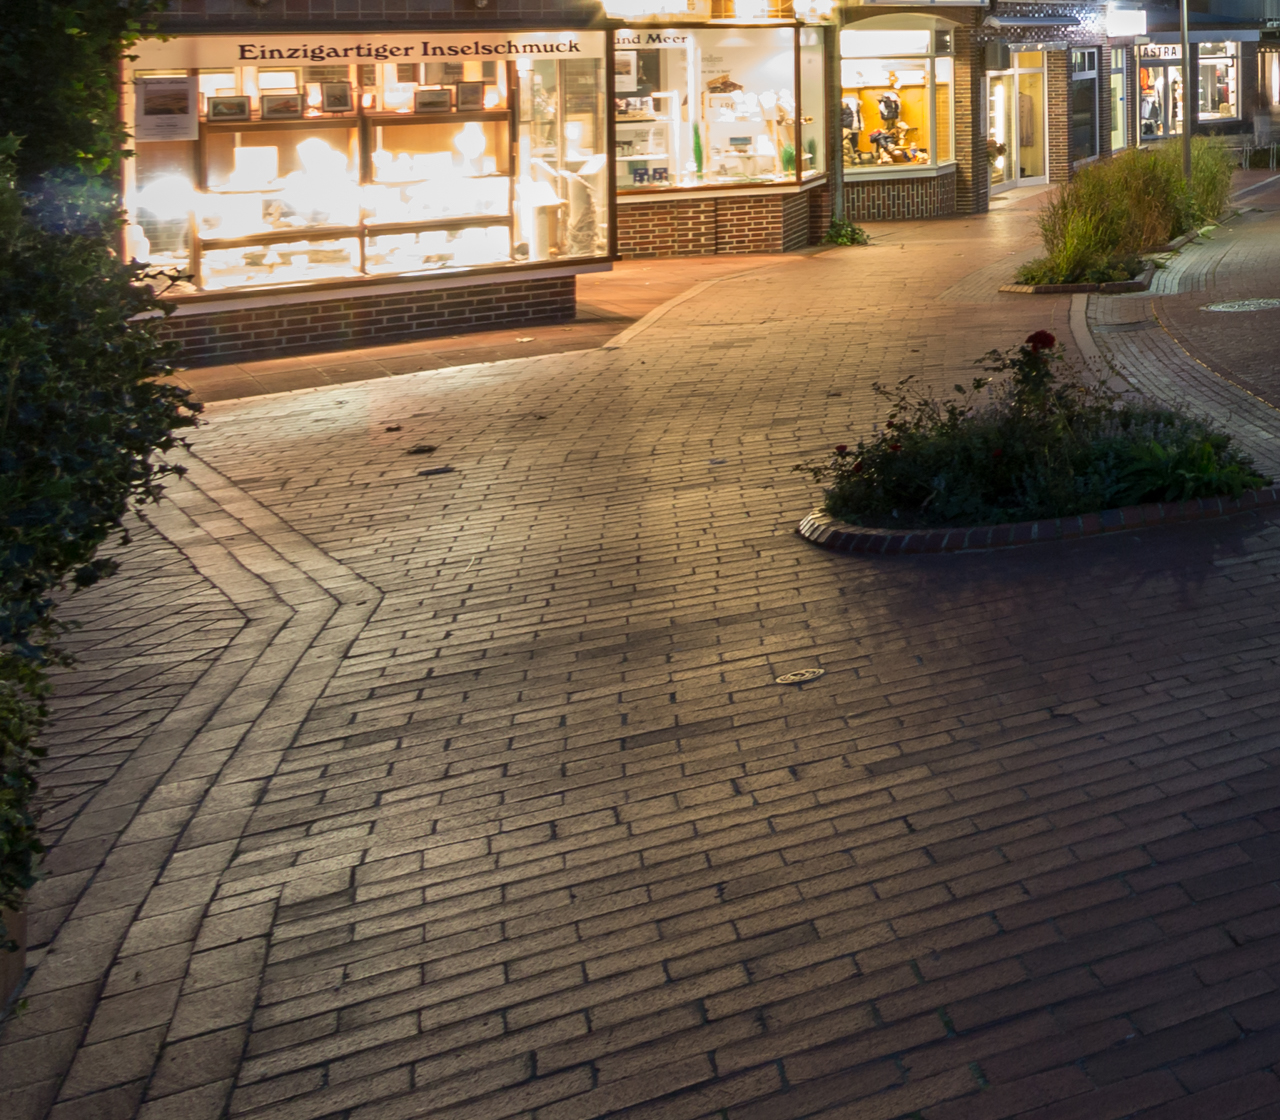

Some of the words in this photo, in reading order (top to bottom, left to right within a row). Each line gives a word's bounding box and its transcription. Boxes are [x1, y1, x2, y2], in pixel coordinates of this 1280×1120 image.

[645, 33, 688, 45] Meer
[238, 42, 415, 62] Einzigartiger
[421, 39, 582, 58] Inselschmuck
